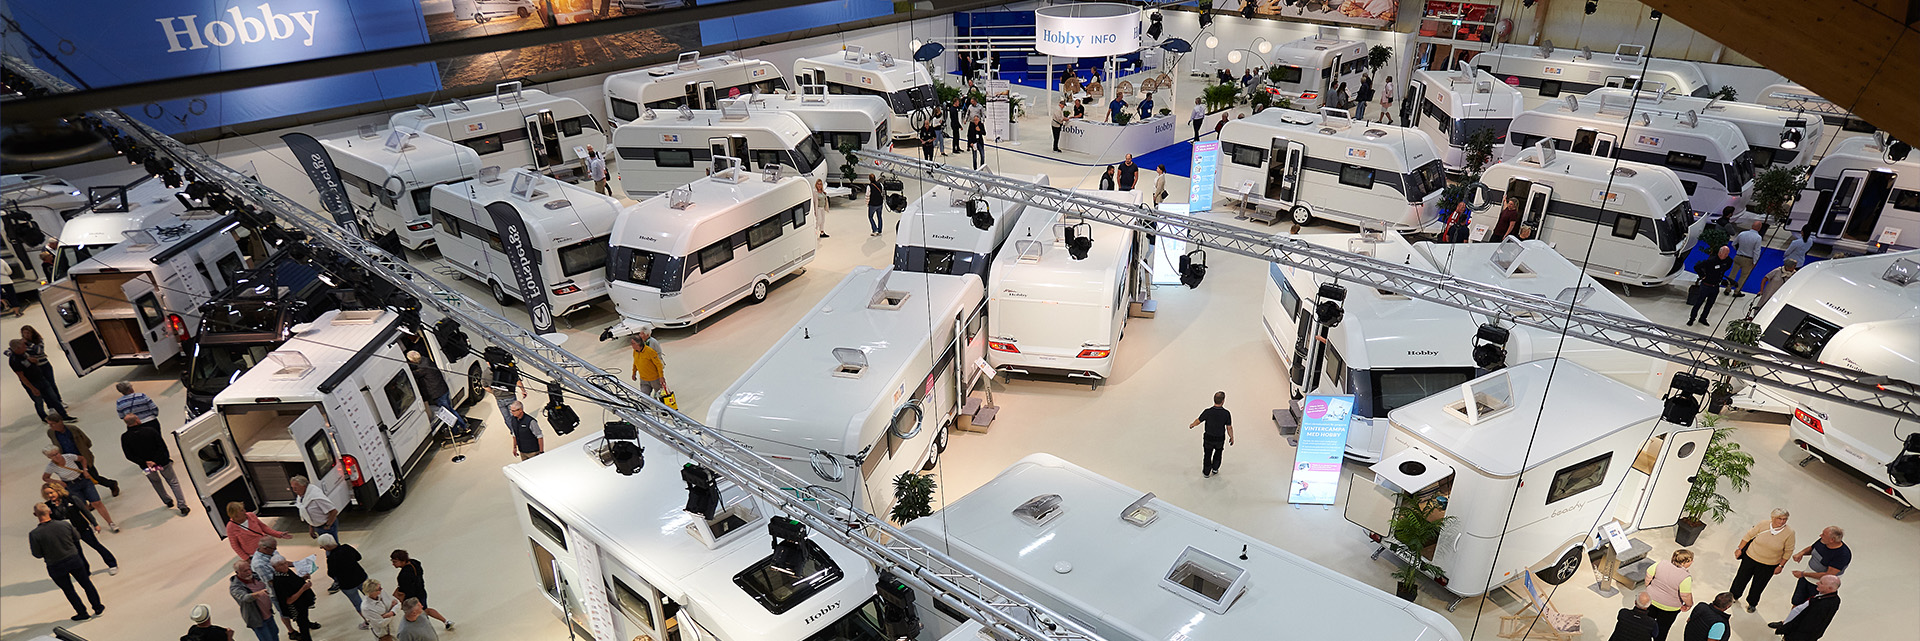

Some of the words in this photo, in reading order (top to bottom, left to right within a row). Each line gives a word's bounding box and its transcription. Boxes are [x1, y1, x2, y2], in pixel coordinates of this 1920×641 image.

[155, 3, 320, 53] Hobby
[1043, 29, 1084, 48] Hobby
[1091, 33, 1117, 44] INFO
[1153, 122, 1174, 134] Hobby
[638, 235, 658, 243] Hobby
[932, 233, 955, 241] Hobby
[1825, 301, 1853, 316] Hobby
[1550, 501, 1586, 519] beachy
[803, 600, 842, 625] Hobby
